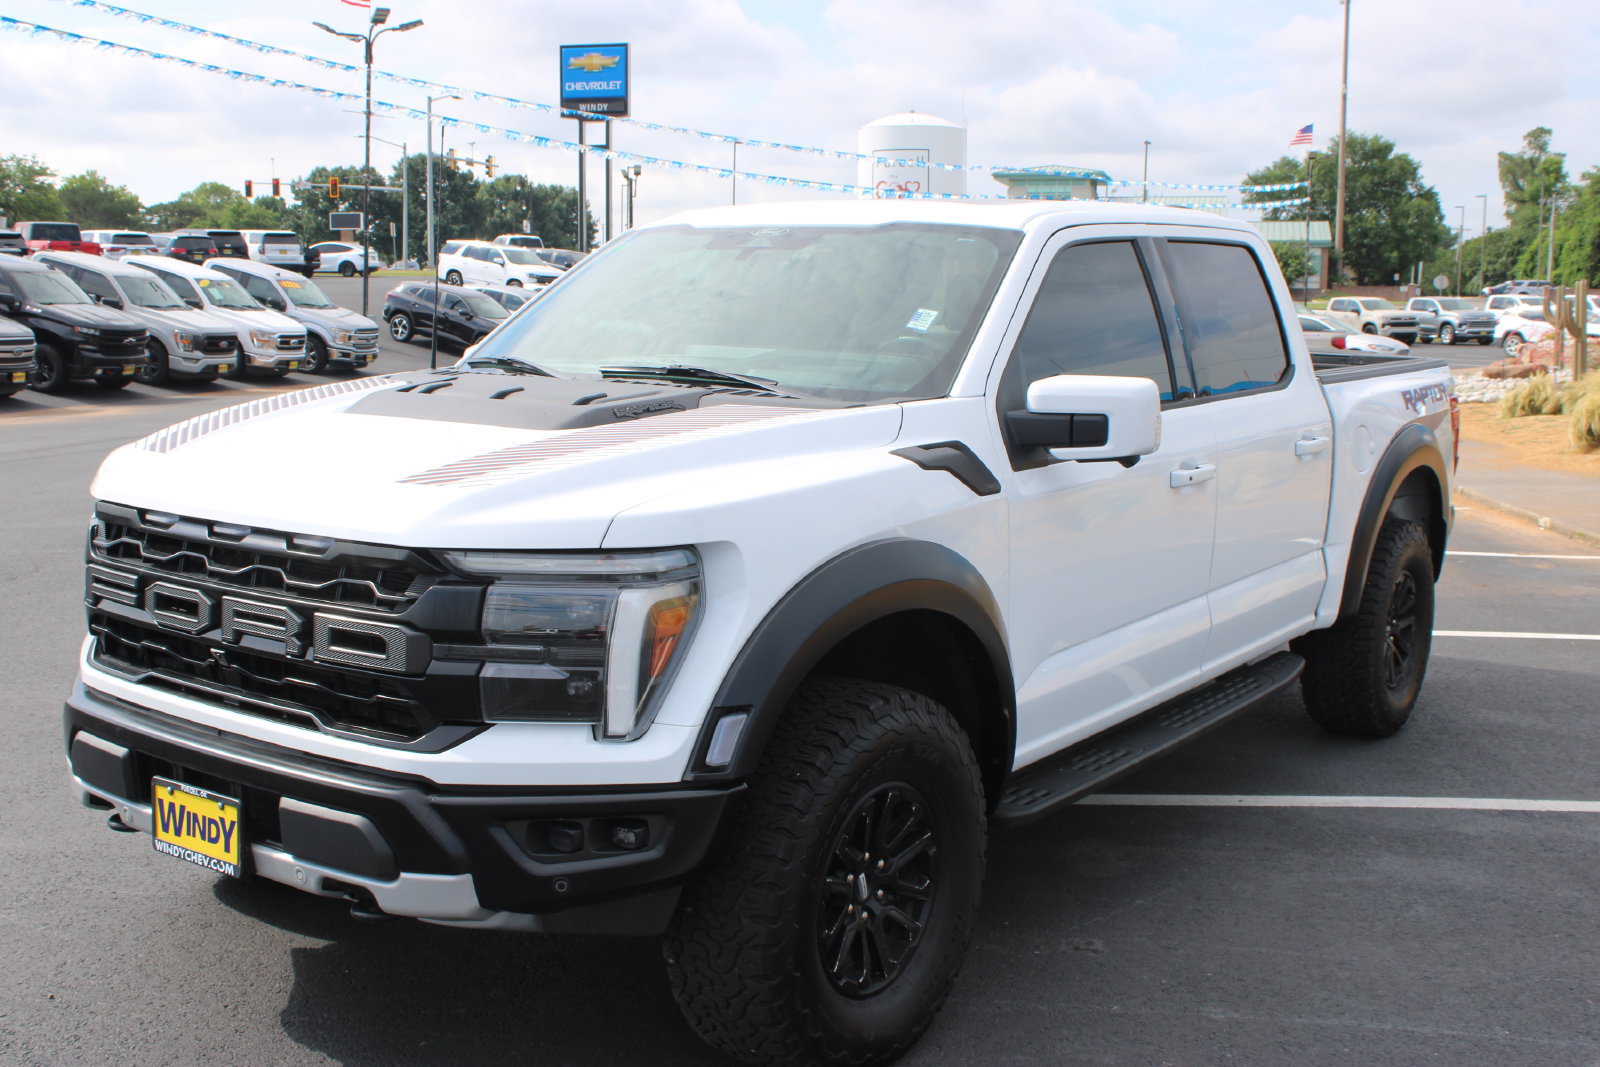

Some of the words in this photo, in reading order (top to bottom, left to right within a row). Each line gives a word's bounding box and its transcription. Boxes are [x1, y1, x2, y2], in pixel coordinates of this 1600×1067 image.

[565, 81, 622, 91] CHEVROLET
[579, 103, 609, 112] WINDY
[1401, 383, 1449, 415] RAPTOR
[86, 563, 431, 680] FORD
[158, 797, 237, 853] WINDY
[155, 839, 235, 876] WINDYCHEV.COM
